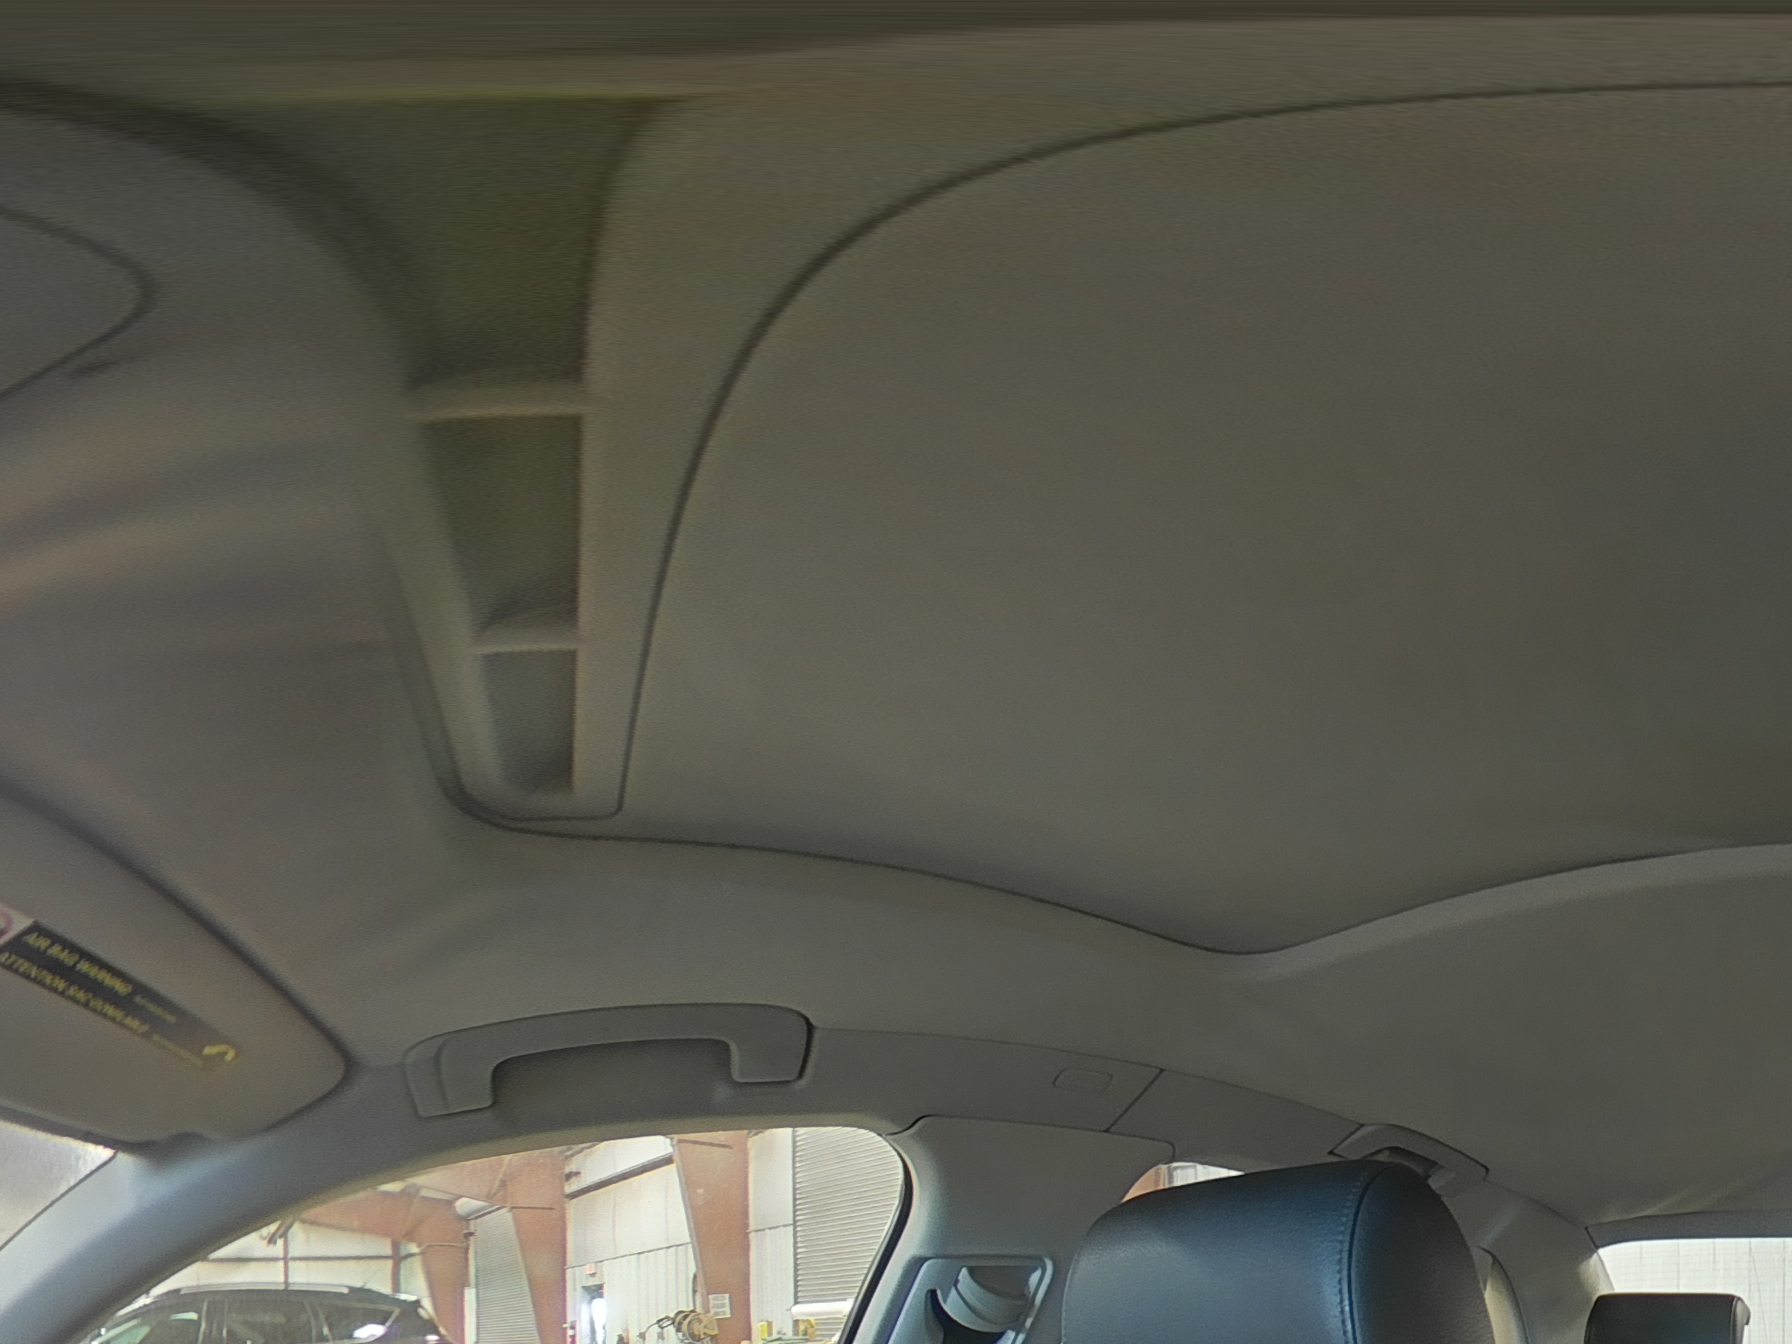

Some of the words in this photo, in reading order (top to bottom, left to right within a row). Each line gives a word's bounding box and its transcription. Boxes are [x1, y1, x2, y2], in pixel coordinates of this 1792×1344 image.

[24, 932, 51, 950] AIR
[46, 945, 80, 967] BAG
[76, 959, 133, 995] WARNING
